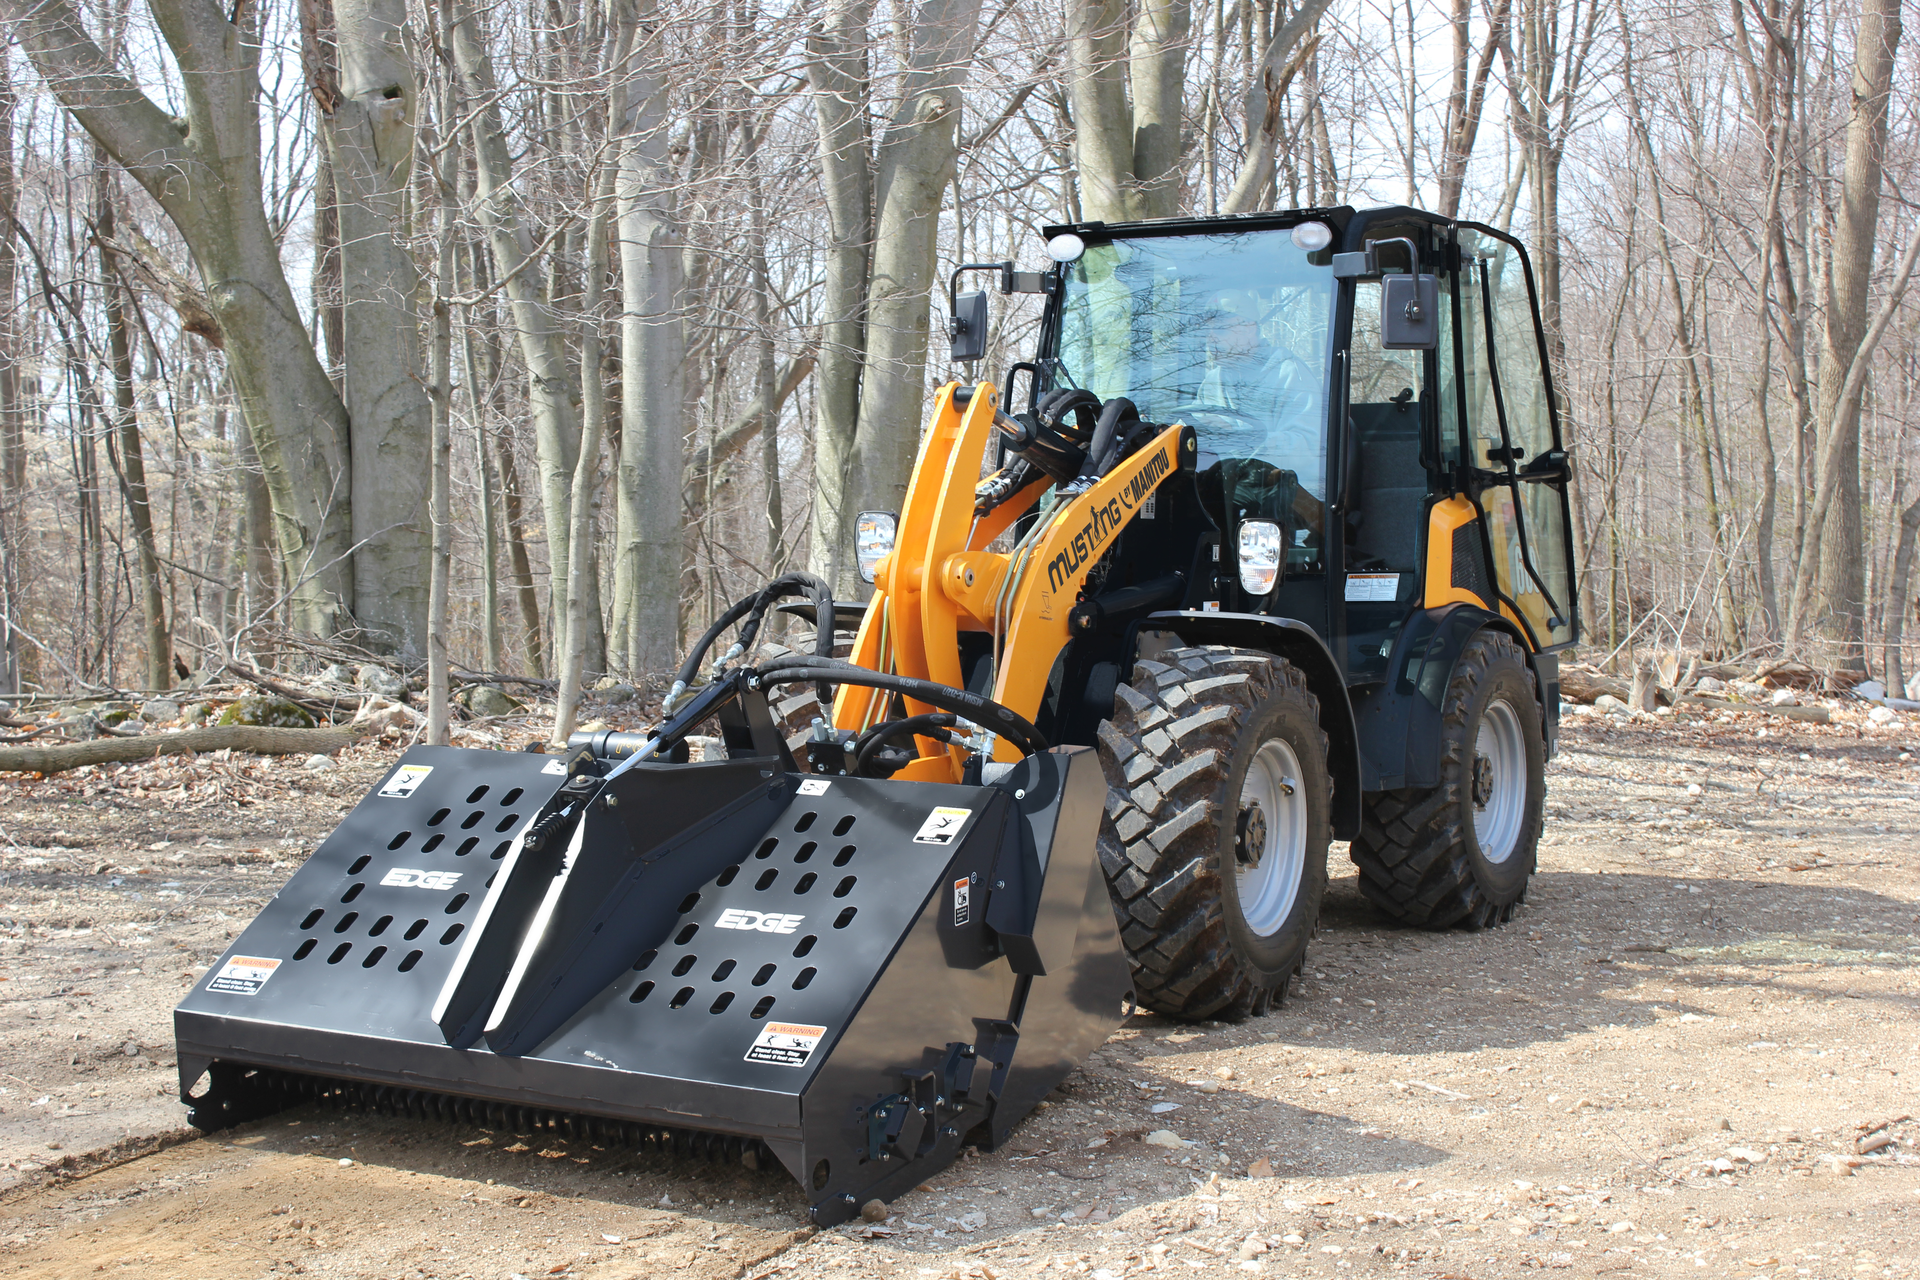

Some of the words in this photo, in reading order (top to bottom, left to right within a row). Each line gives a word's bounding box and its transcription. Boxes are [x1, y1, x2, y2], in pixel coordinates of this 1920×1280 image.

[1123, 484, 1131, 499] BY
[1130, 447, 1170, 504] MANITOU
[379, 867, 464, 891] EDGE
[713, 908, 806, 935] EDGE
[241, 959, 276, 968] WARNING
[779, 1026, 820, 1036] WARNING
